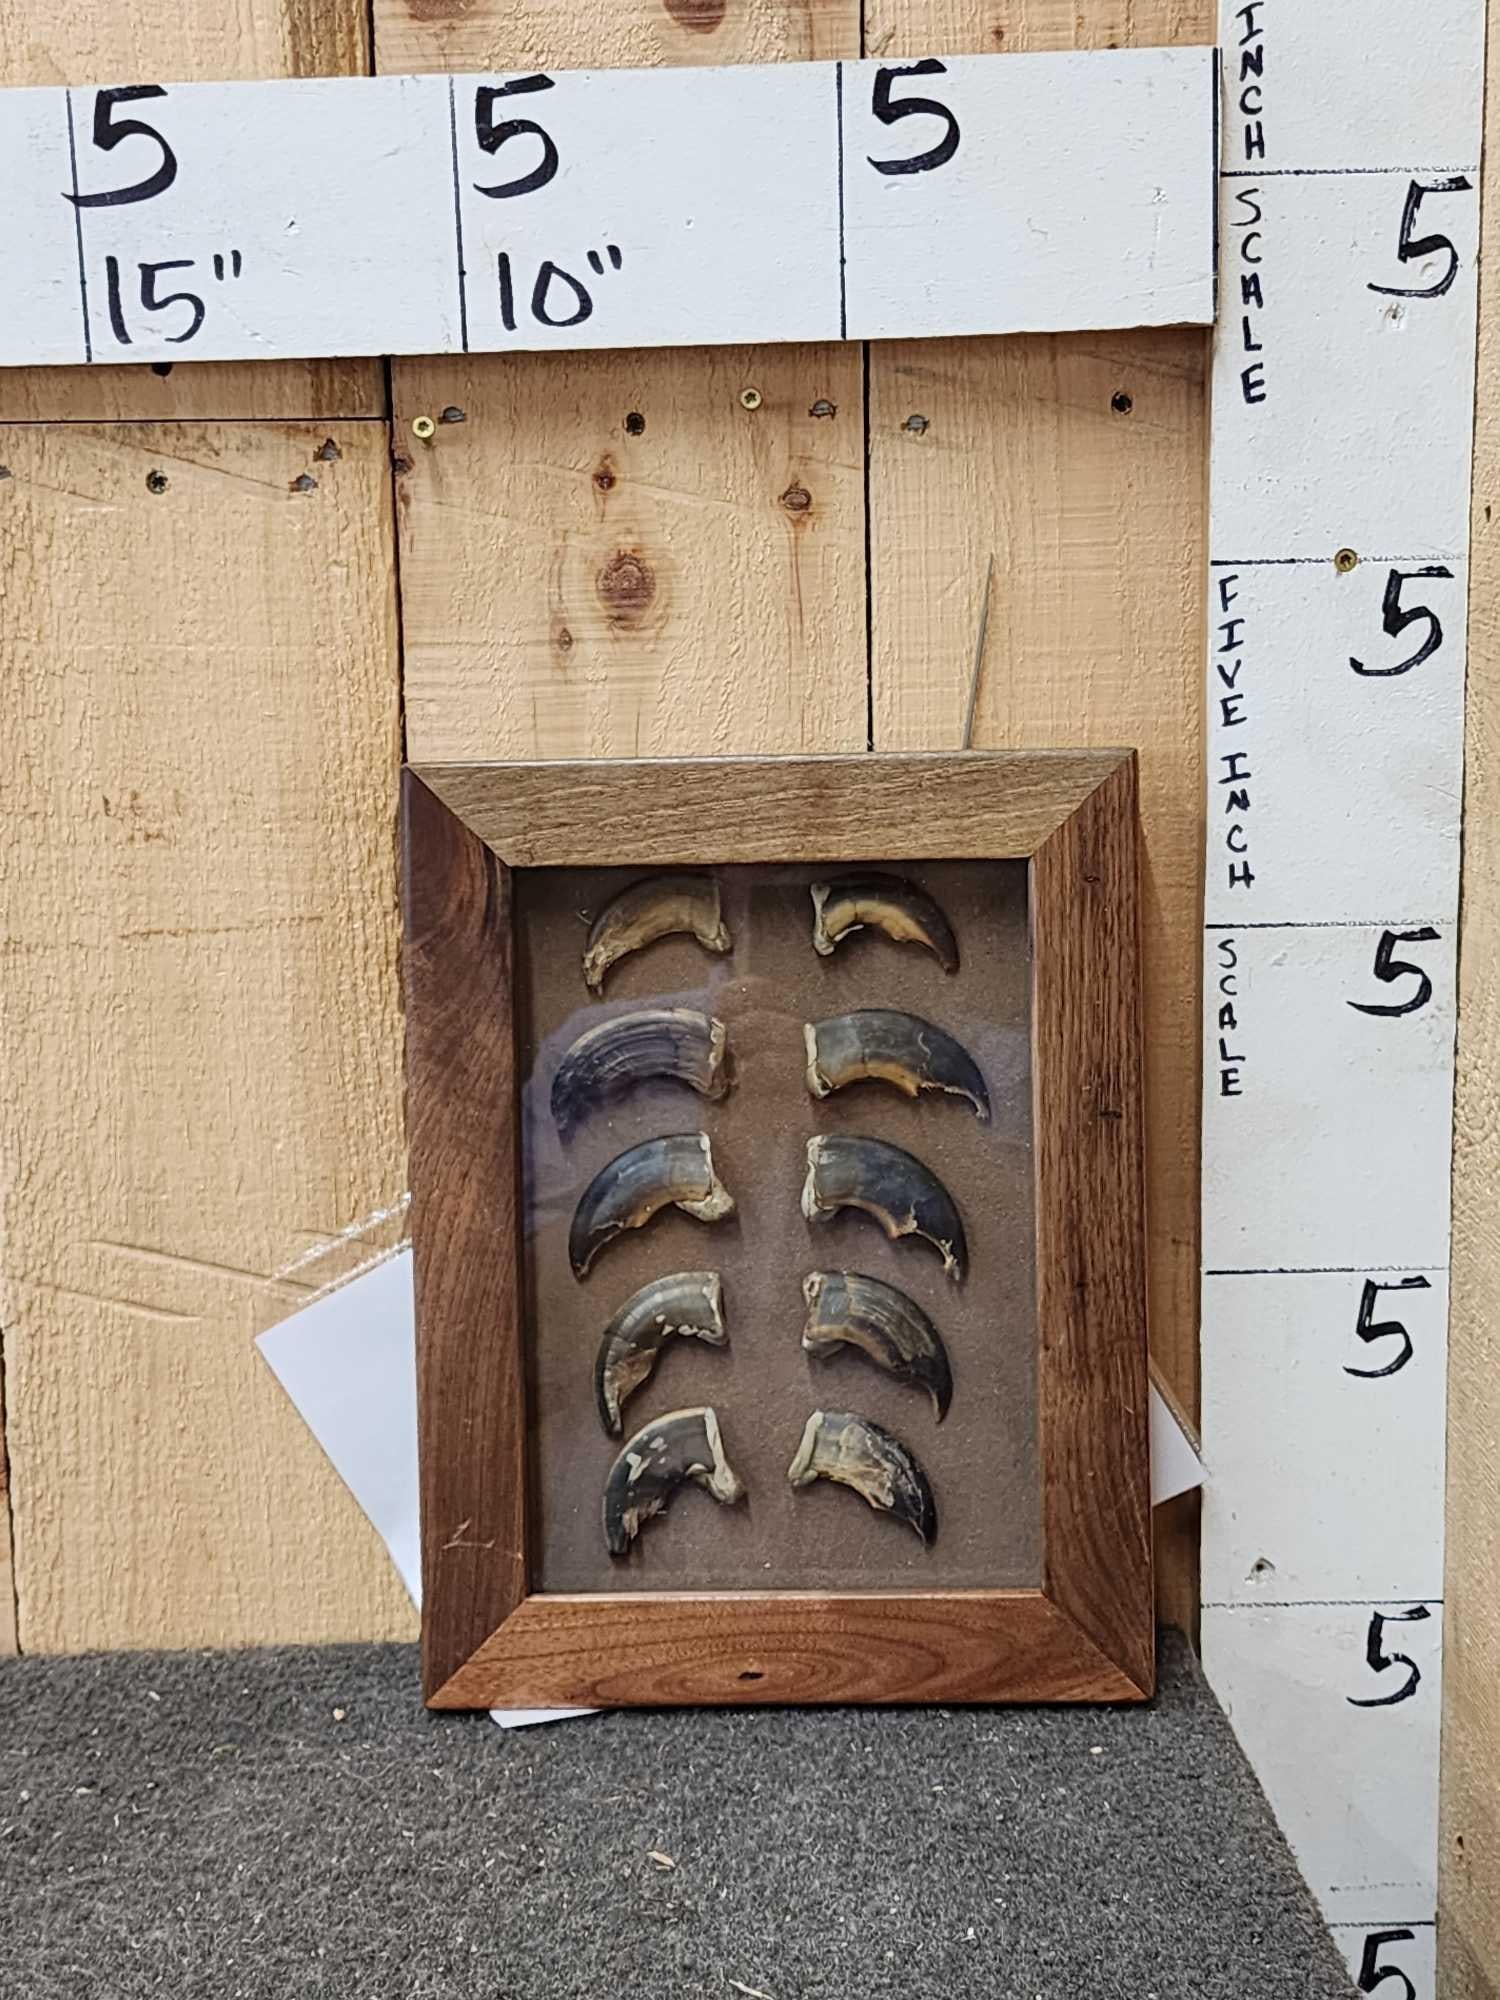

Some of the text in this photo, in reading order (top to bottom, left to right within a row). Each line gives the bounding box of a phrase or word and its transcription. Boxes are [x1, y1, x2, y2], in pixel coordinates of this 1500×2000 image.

[61, 84, 178, 208] 5
[473, 73, 559, 199] 5
[867, 57, 961, 176] 5
[1230, 1, 1267, 404] INCH SCALE
[1366, 175, 1474, 299] 5
[1349, 565, 1455, 677] 5
[1217, 574, 1256, 1097] FIVE INCH SCALE
[1346, 926, 1442, 1018] 5
[1343, 1275, 1432, 1379] 5
[1346, 1604, 1432, 1708] 5
[1357, 1928, 1417, 2000] 5
